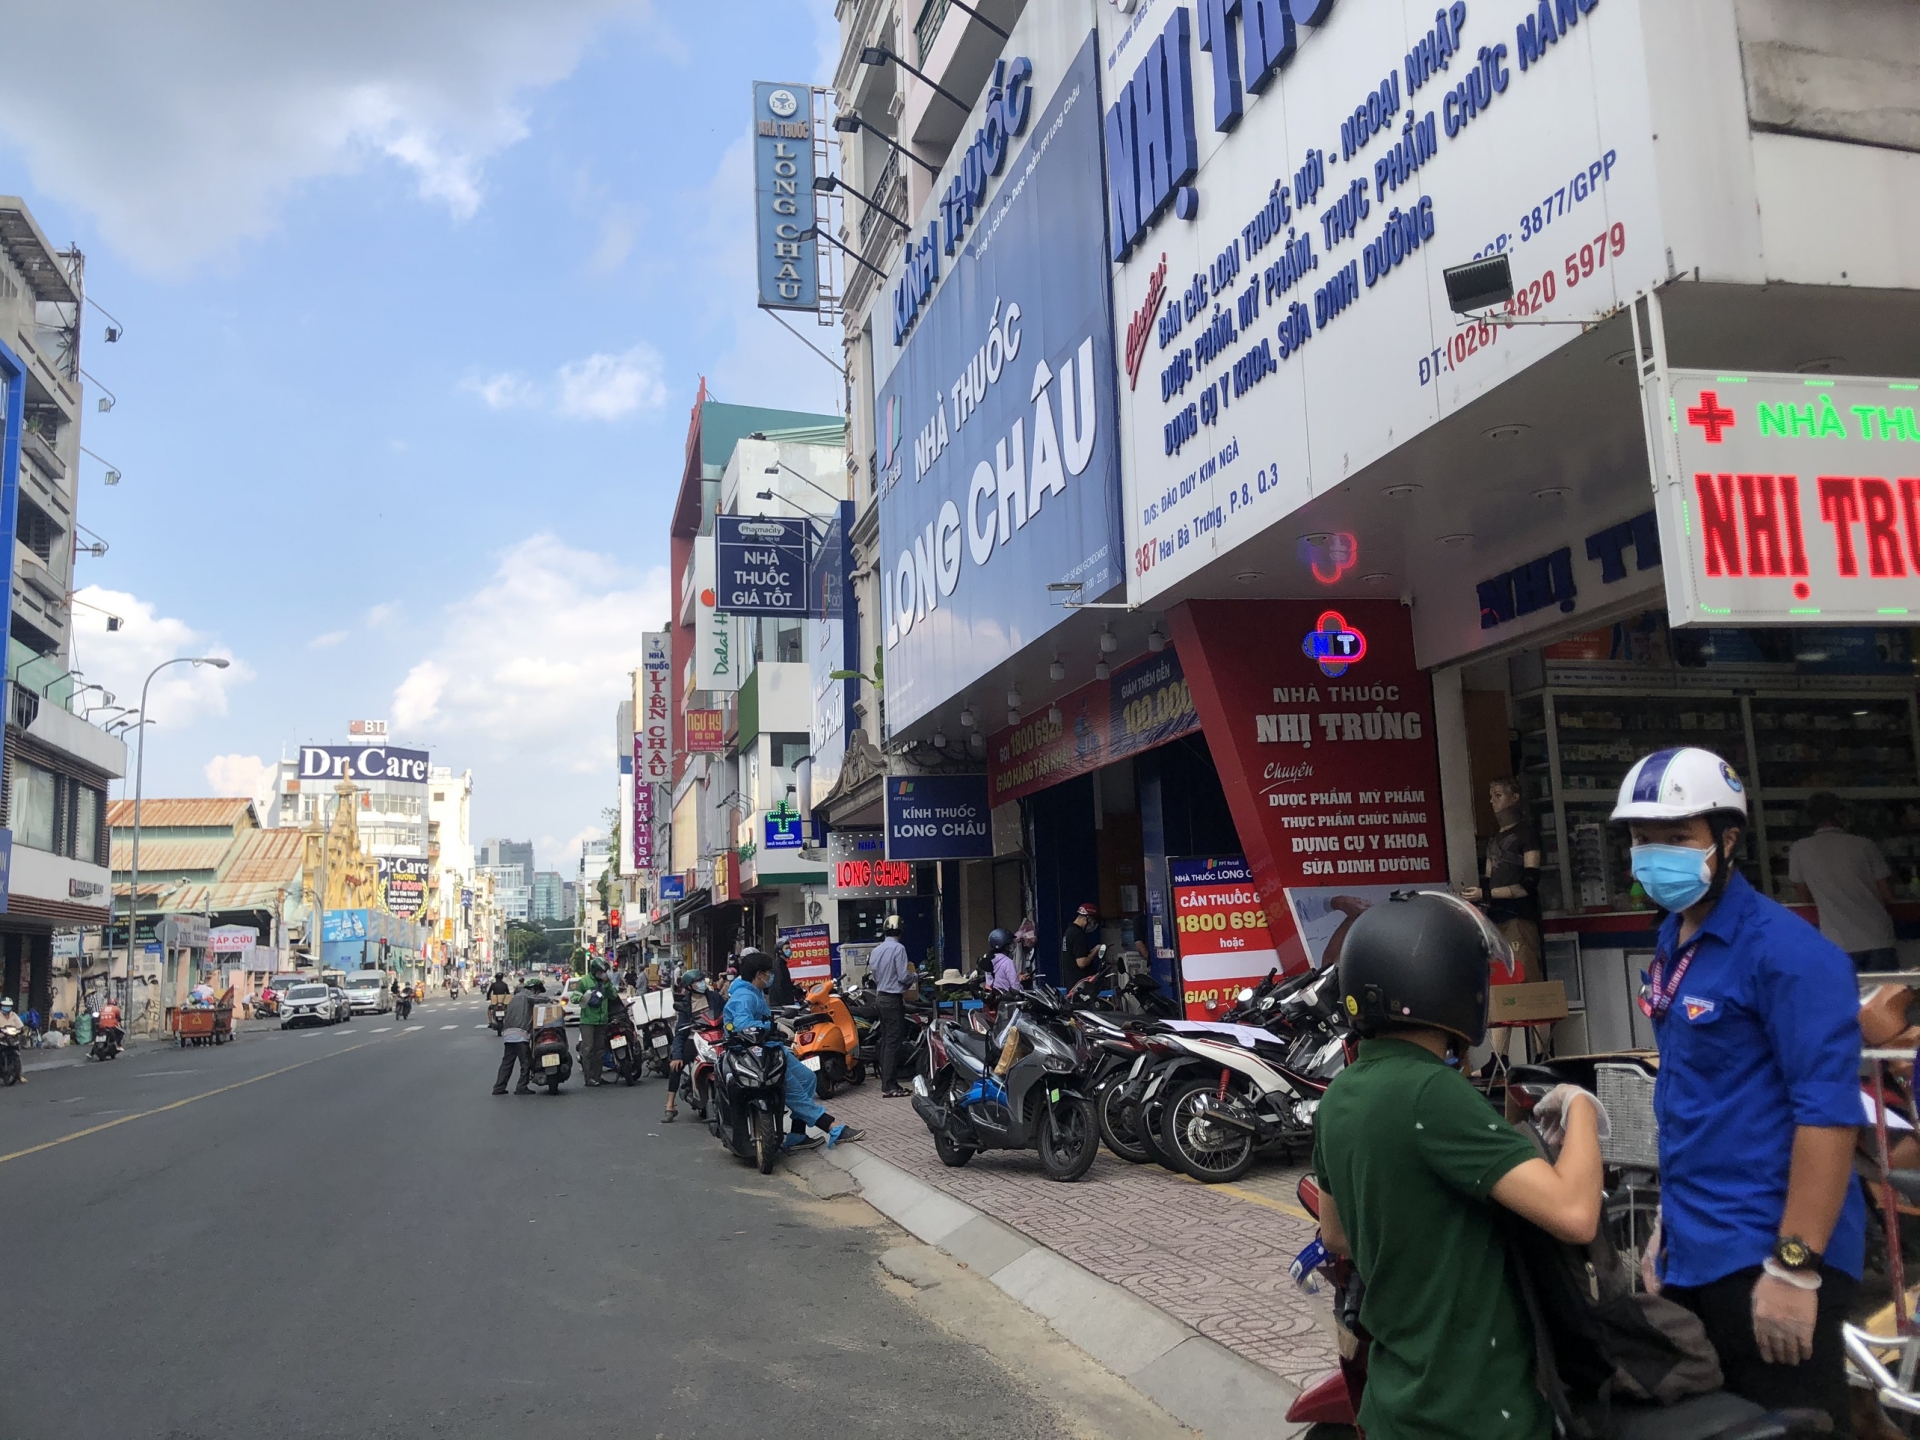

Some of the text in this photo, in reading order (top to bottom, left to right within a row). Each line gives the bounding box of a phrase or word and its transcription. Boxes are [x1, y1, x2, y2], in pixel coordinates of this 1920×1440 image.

[759, 118, 809, 139] NHÀ THUỐC
[1106, 6, 1198, 263] NHỊ
[1158, 301, 1182, 349] BÁN
[1183, 273, 1208, 324] CÁC
[1209, 238, 1240, 297] LOẠI
[1242, 178, 1291, 262] THUỐC
[1294, 148, 1325, 210] NỘI
[1340, 69, 1400, 162] NGOẠI
[1404, 0, 1466, 96] NHẬP
[893, 56, 1033, 346] KÍNH THUỐC
[1519, 149, 1617, 243] 3877/GPP
[773, 143, 802, 300] LONG CHÂU
[1160, 43, 1510, 403] DƯỢC PHẨM, MỸ PHẨM, THỰC PHẨM CHỨC
[1503, 269, 1556, 330] 3820
[1565, 221, 1626, 288] 5979
[1163, 195, 1435, 457] DỤNG CỤ Y KHOA, SỮA DINH DƯỠNG
[915, 296, 1022, 483] NHÀ THUỐC
[1757, 393, 1847, 440] NHÀ
[1161, 486, 1178, 513] ĐÀO
[1179, 471, 1197, 499] DUY
[1200, 456, 1217, 484] KIM
[1219, 435, 1240, 469] NGÀ
[885, 500, 962, 651] LONG
[967, 336, 1097, 566] CHÂU
[1134, 537, 1157, 577] 387
[1159, 534, 1175, 562] Hai
[1177, 523, 1190, 550] Bà
[1257, 462, 1279, 494] Q.3
[1694, 473, 1812, 600] NHỊ
[744, 549, 780, 566] NHÀ
[733, 566, 790, 586] THUỐC
[1476, 546, 1577, 629] NHỊ
[731, 587, 793, 606] GIÁ TỐT
[648, 650, 665, 660] NHÀ
[713, 629, 729, 676] Dalat
[644, 660, 670, 671] THUỐC
[1273, 679, 1400, 703] NHÀ THUỐC
[647, 671, 669, 777] LIÊN CHÂU
[1256, 705, 1422, 749] NHỊ TRƯNG
[1010, 724, 1034, 757] 1800
[301, 748, 426, 780] Dr.Care
[1012, 761, 1034, 786] HÀNG
[1263, 761, 1315, 783] Chuyên
[1268, 785, 1426, 809] DƯỢC PHẨM MỸ PHẨM
[902, 803, 977, 819] KÍNH THUỐC
[1281, 810, 1427, 831] THỰC PHẨM CHỨC NĂNG
[894, 820, 986, 839] LONG CHÂU
[858, 839, 876, 850] NHÀ
[1292, 833, 1429, 855] DỤNG CỤ Y KHOA
[837, 860, 871, 888] LONG
[1175, 869, 1244, 883] NHÀ THUỐC LONG
[1302, 856, 1430, 875] SỮA DINH DƯỠNG
[1180, 891, 1207, 908] CẦN
[1209, 888, 1251, 906] THUỐC
[1177, 913, 1226, 933] 1800
[797, 940, 816, 948] THUỐC
[806, 948, 830, 957] 6928
[1220, 937, 1245, 949] hoặc
[1184, 988, 1219, 1004] GIAO
